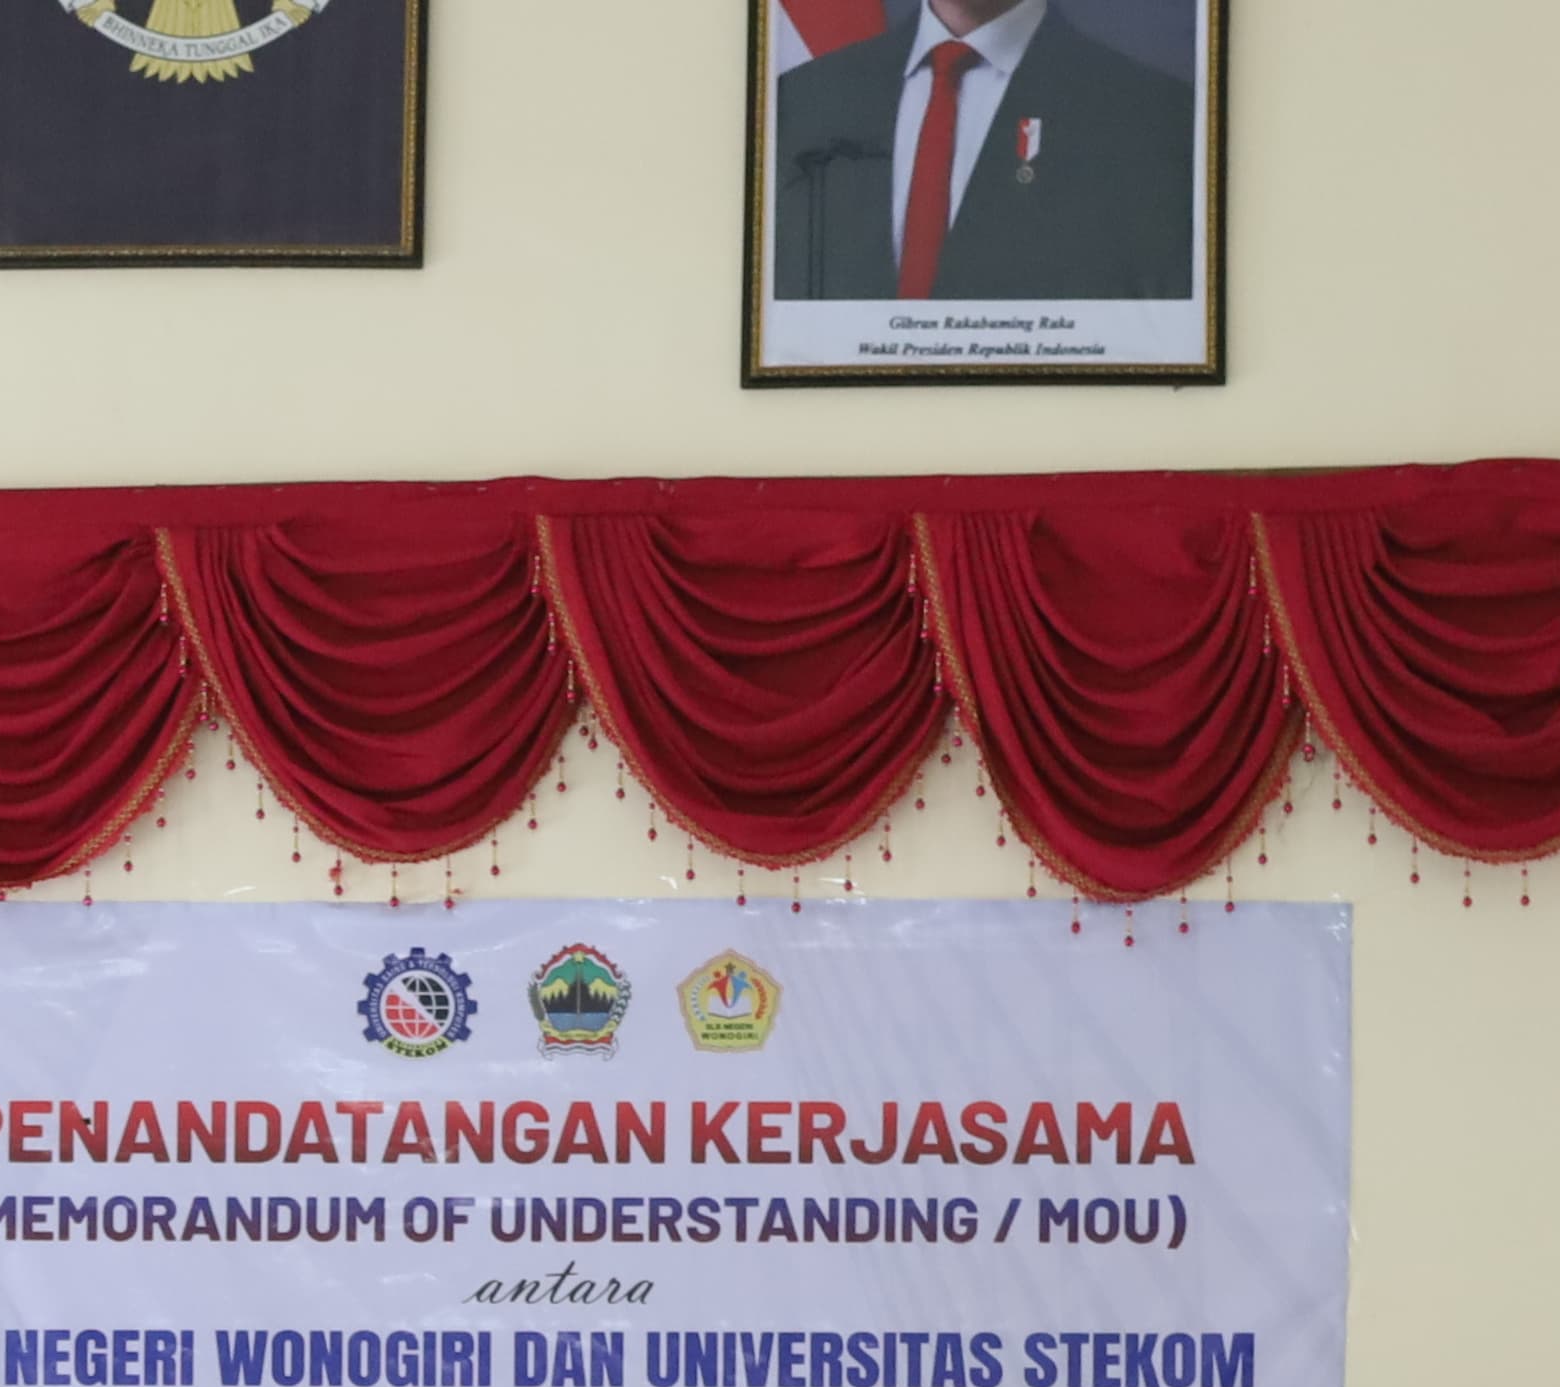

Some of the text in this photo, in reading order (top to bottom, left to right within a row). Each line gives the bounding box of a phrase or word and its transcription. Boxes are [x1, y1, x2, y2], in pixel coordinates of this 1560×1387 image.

[102, 16, 287, 57] BHINNEKA TUNGGAL IKA
[889, 316, 937, 329] Gibran
[1039, 317, 1075, 329] Raka
[859, 343, 1105, 357] Wakil Presiden Republik Indonesia
[701, 1032, 758, 1040] WONOGIRI
[691, 1101, 1195, 1165] KERJASAMA
[403, 1196, 475, 1243] OF
[490, 1196, 978, 1243] UNDERSTANDING
[1038, 1194, 1188, 1249] MOU)
[461, 1260, 654, 1305] antara
[5, 1330, 193, 1386] NEGERI
[216, 1330, 491, 1387] WONOGIRI
[513, 1331, 624, 1387] DAN
